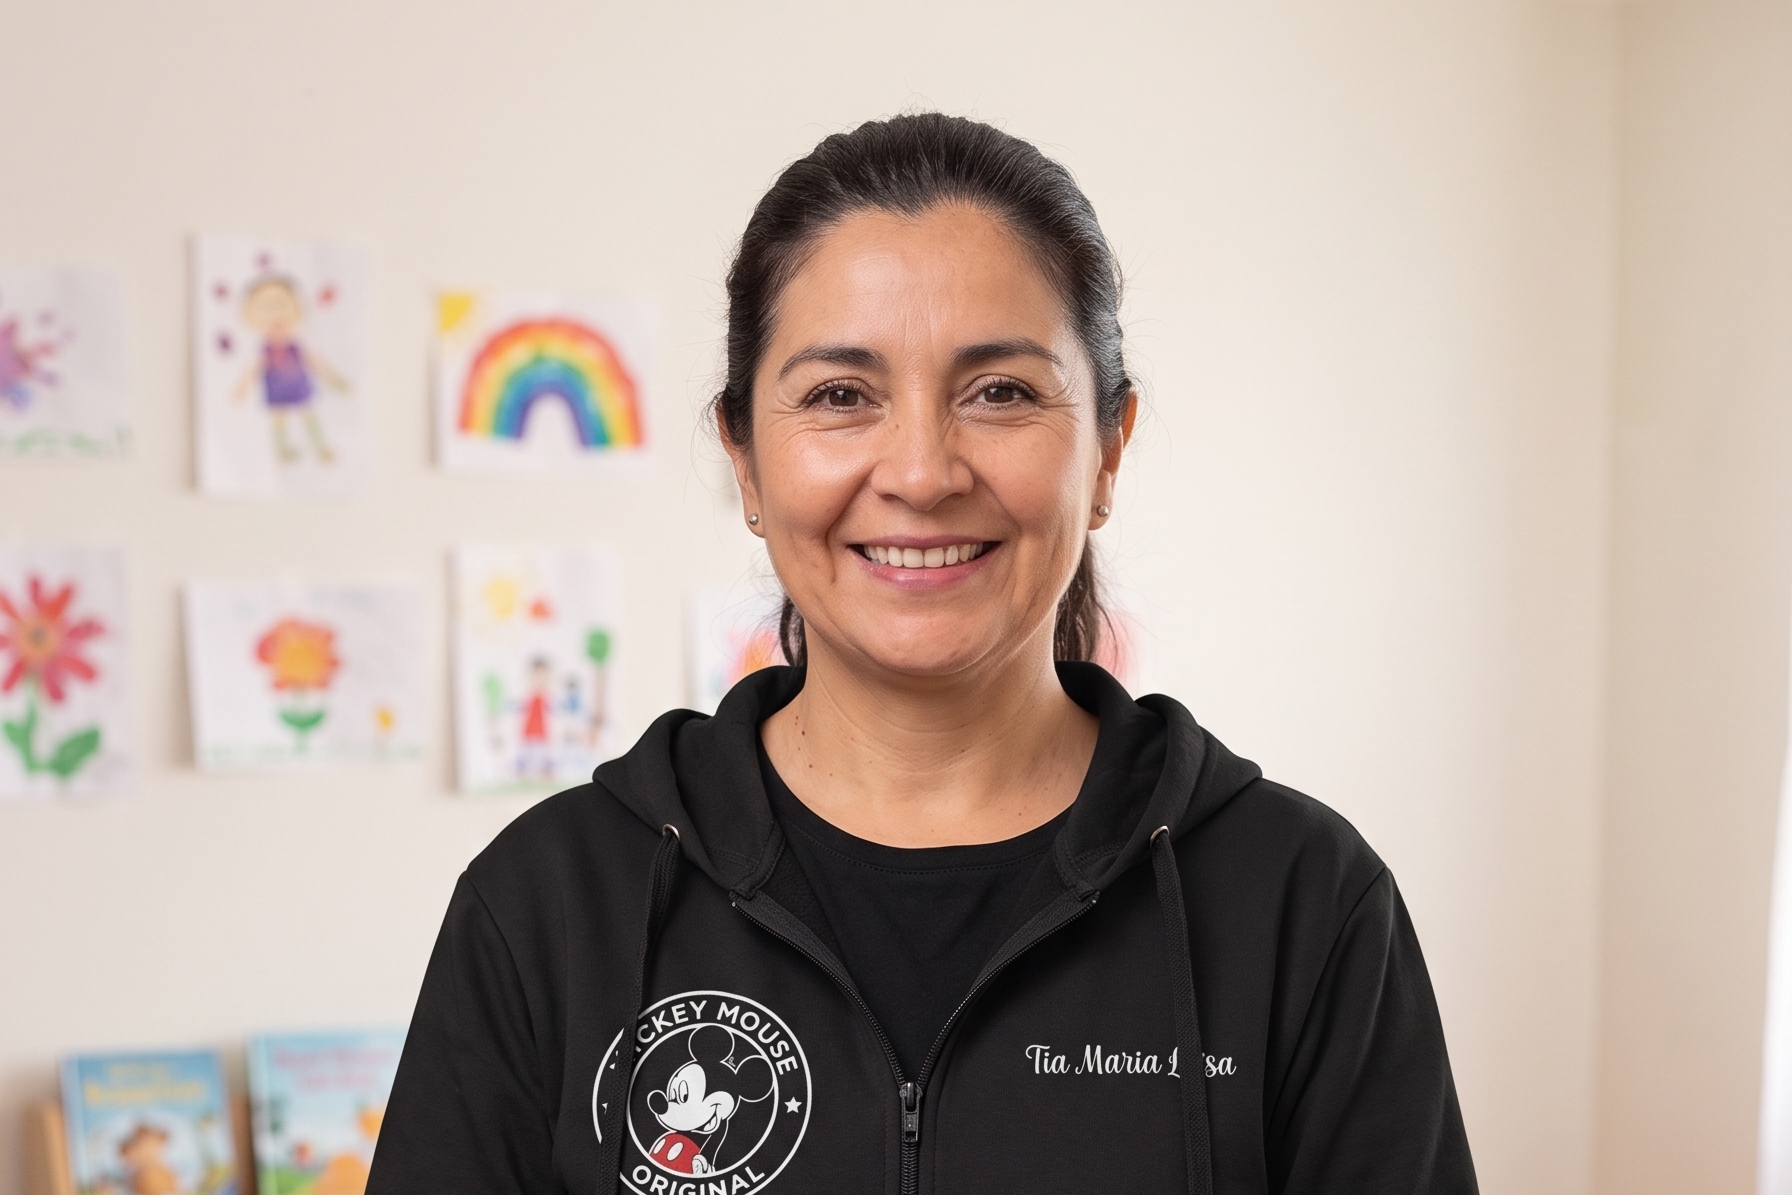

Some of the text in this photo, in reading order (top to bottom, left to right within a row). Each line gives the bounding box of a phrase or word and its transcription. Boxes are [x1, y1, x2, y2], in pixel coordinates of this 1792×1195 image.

[609, 1000, 799, 1076] CKEY MOUSE
[1025, 1044, 1237, 1078] Tia Maria Lsa
